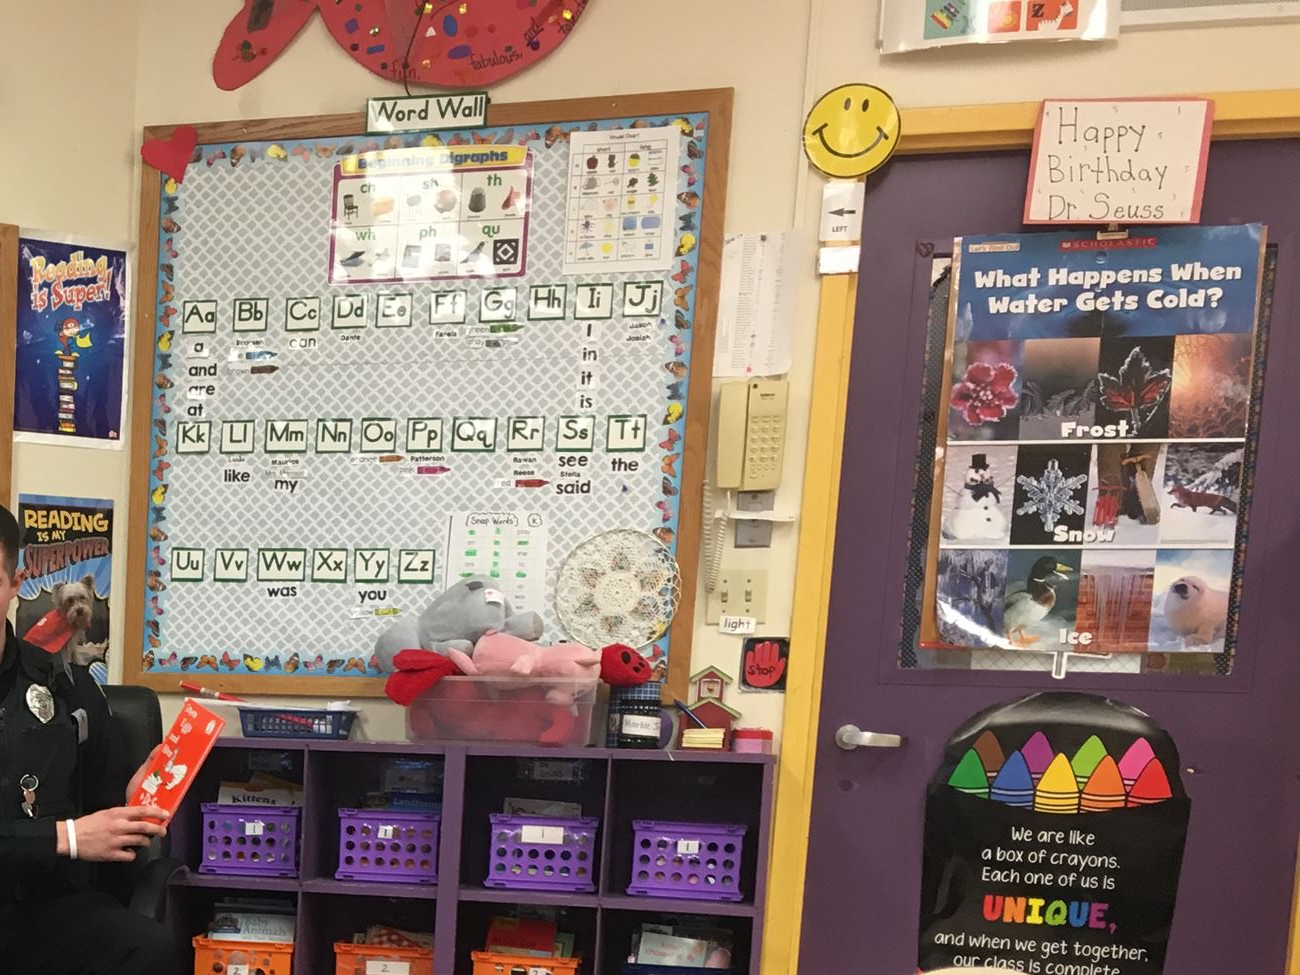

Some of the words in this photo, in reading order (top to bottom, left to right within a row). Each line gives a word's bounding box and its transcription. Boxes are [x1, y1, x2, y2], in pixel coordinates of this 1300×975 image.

[371, 99, 429, 122] Word
[436, 96, 484, 119] Wall
[1058, 107, 1146, 154] Happy
[486, 173, 502, 187] th
[1047, 154, 1168, 190] Birthday
[1048, 194, 1077, 221] Dr
[1088, 192, 1165, 220] Seuss
[482, 223, 501, 237] qu
[1073, 238, 1156, 250] SCHOLASTIC
[30, 250, 108, 283] Reading
[974, 268, 1040, 289] What
[1048, 265, 1163, 289] Happens
[1171, 262, 1242, 281] When
[31, 288, 48, 312] is
[51, 267, 113, 311] Super!
[534, 288, 561, 309] Hh
[988, 294, 1068, 314] Water
[1076, 290, 1139, 312] Gets
[1146, 287, 1224, 310] Cold?
[185, 304, 215, 324] Aa
[289, 336, 317, 348] can
[188, 363, 217, 377] and
[580, 394, 593, 409] is
[269, 423, 304, 442] Mm
[1061, 421, 1130, 438] Frost
[558, 455, 589, 467] see
[611, 458, 639, 471] the
[223, 469, 251, 482] like
[274, 479, 298, 493] my
[555, 480, 591, 494] said
[24, 509, 109, 533] READING
[36, 531, 49, 542] IS
[52, 530, 66, 541] MY
[1053, 524, 1116, 544] Snow
[24, 537, 109, 578] SUPERPOWER
[404, 552, 430, 572] Zz
[267, 586, 297, 597] was
[358, 590, 387, 604] you
[724, 617, 751, 632] light
[1060, 628, 1092, 646] Ice
[232, 793, 277, 805] Kittens
[1011, 826, 1033, 842] We
[1037, 831, 1065, 843] are
[1069, 830, 1096, 845] like
[981, 848, 992, 860] a
[996, 847, 1023, 862] box
[1028, 849, 1046, 864] of
[1050, 853, 1121, 871] crayons.
[982, 867, 1020, 883] Each
[1024, 871, 1054, 885] one
[1058, 872, 1077, 887] of
[1081, 876, 1099, 889] us
[1102, 875, 1116, 890] is
[982, 894, 1117, 934] UNIQUE,
[934, 932, 965, 947] and
[968, 933, 1011, 950] when
[1015, 939, 1037, 952] we
[1041, 941, 1068, 959] get
[233, 967, 242, 975] 2
[953, 953, 981, 968] our
[984, 955, 1025, 971] class
[1029, 959, 1041, 973] is
